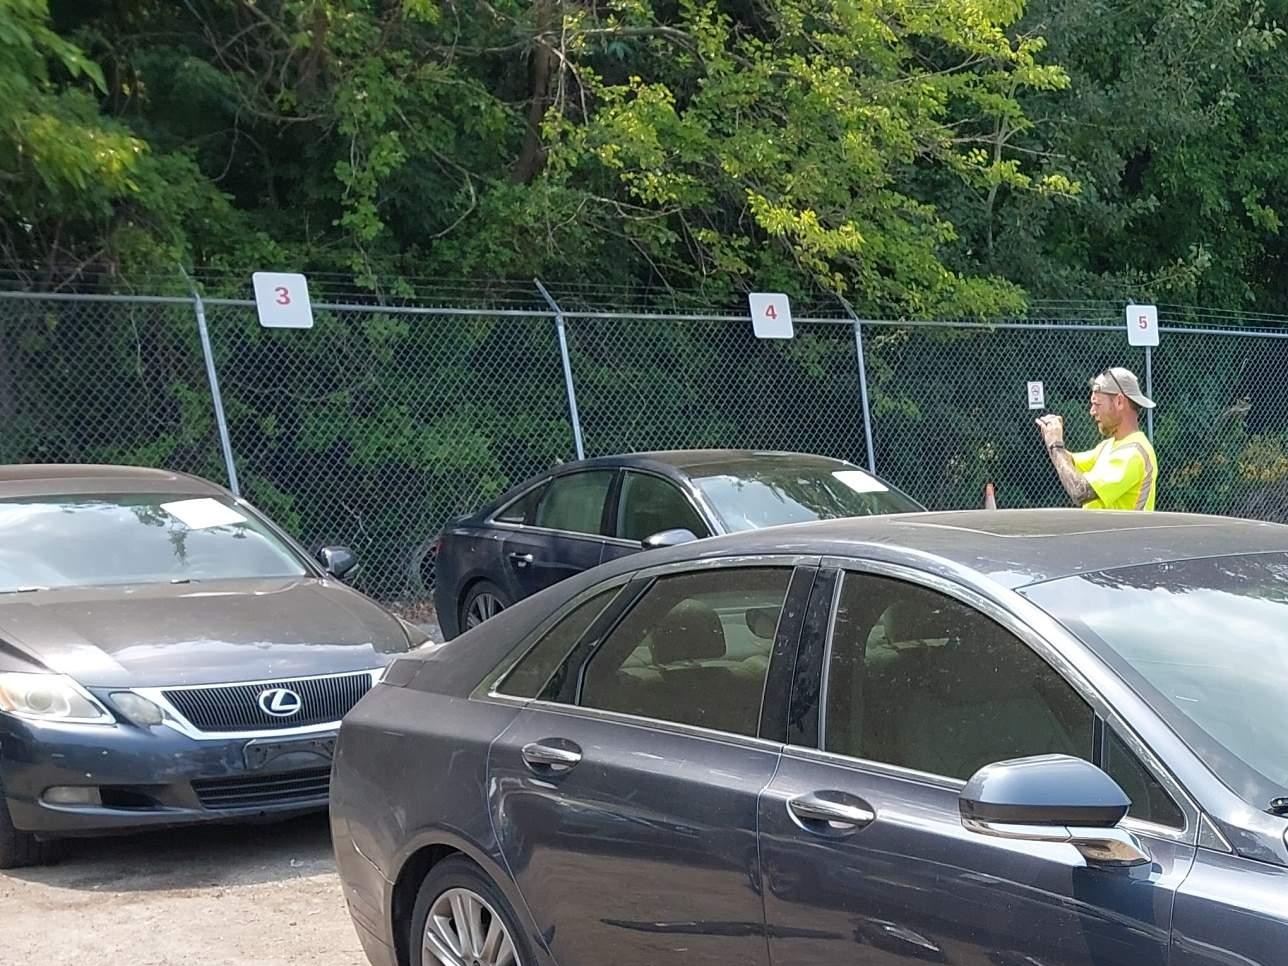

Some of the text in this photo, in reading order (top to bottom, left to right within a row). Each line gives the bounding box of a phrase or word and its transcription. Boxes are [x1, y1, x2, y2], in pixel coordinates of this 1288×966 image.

[274, 286, 291, 305] 3
[765, 304, 778, 320] 4
[1138, 315, 1148, 329] 5
